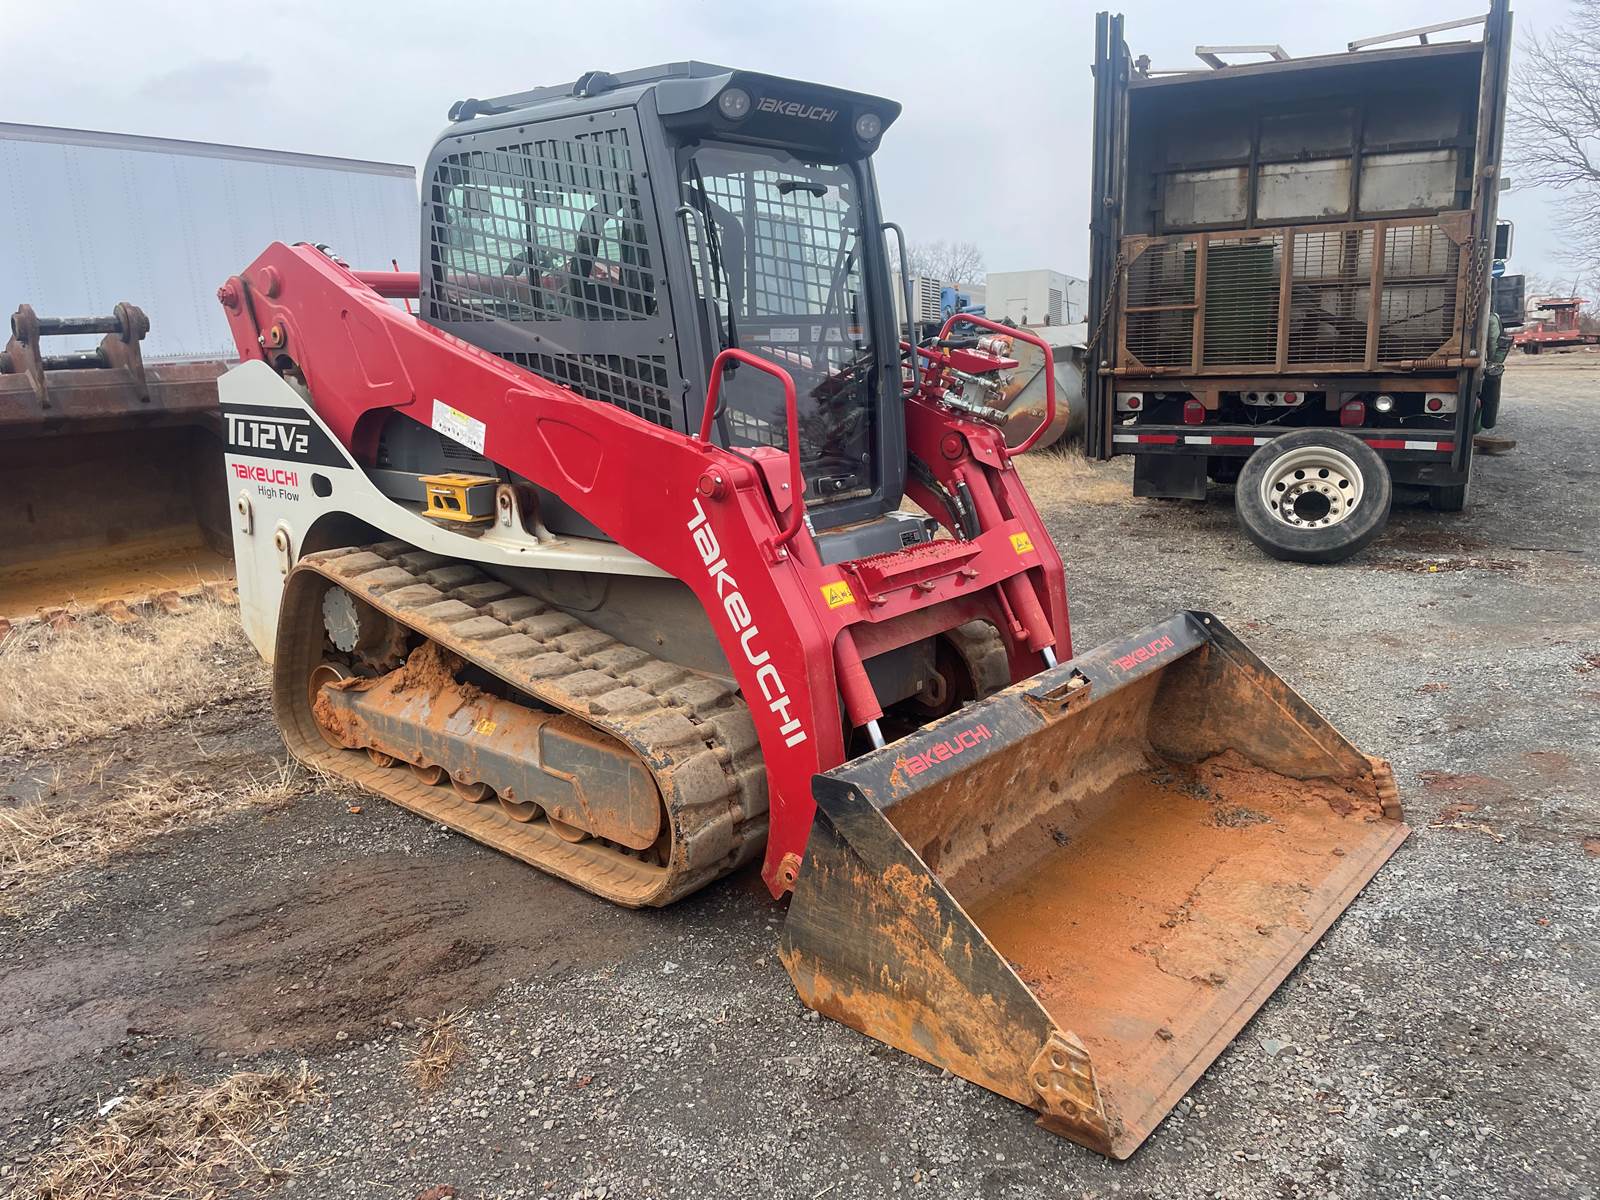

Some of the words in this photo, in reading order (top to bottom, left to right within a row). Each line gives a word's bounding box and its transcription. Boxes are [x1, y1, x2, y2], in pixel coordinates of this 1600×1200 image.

[224, 413, 310, 453] TL12V2
[258, 485, 277, 499] High
[279, 488, 299, 502] Flow
